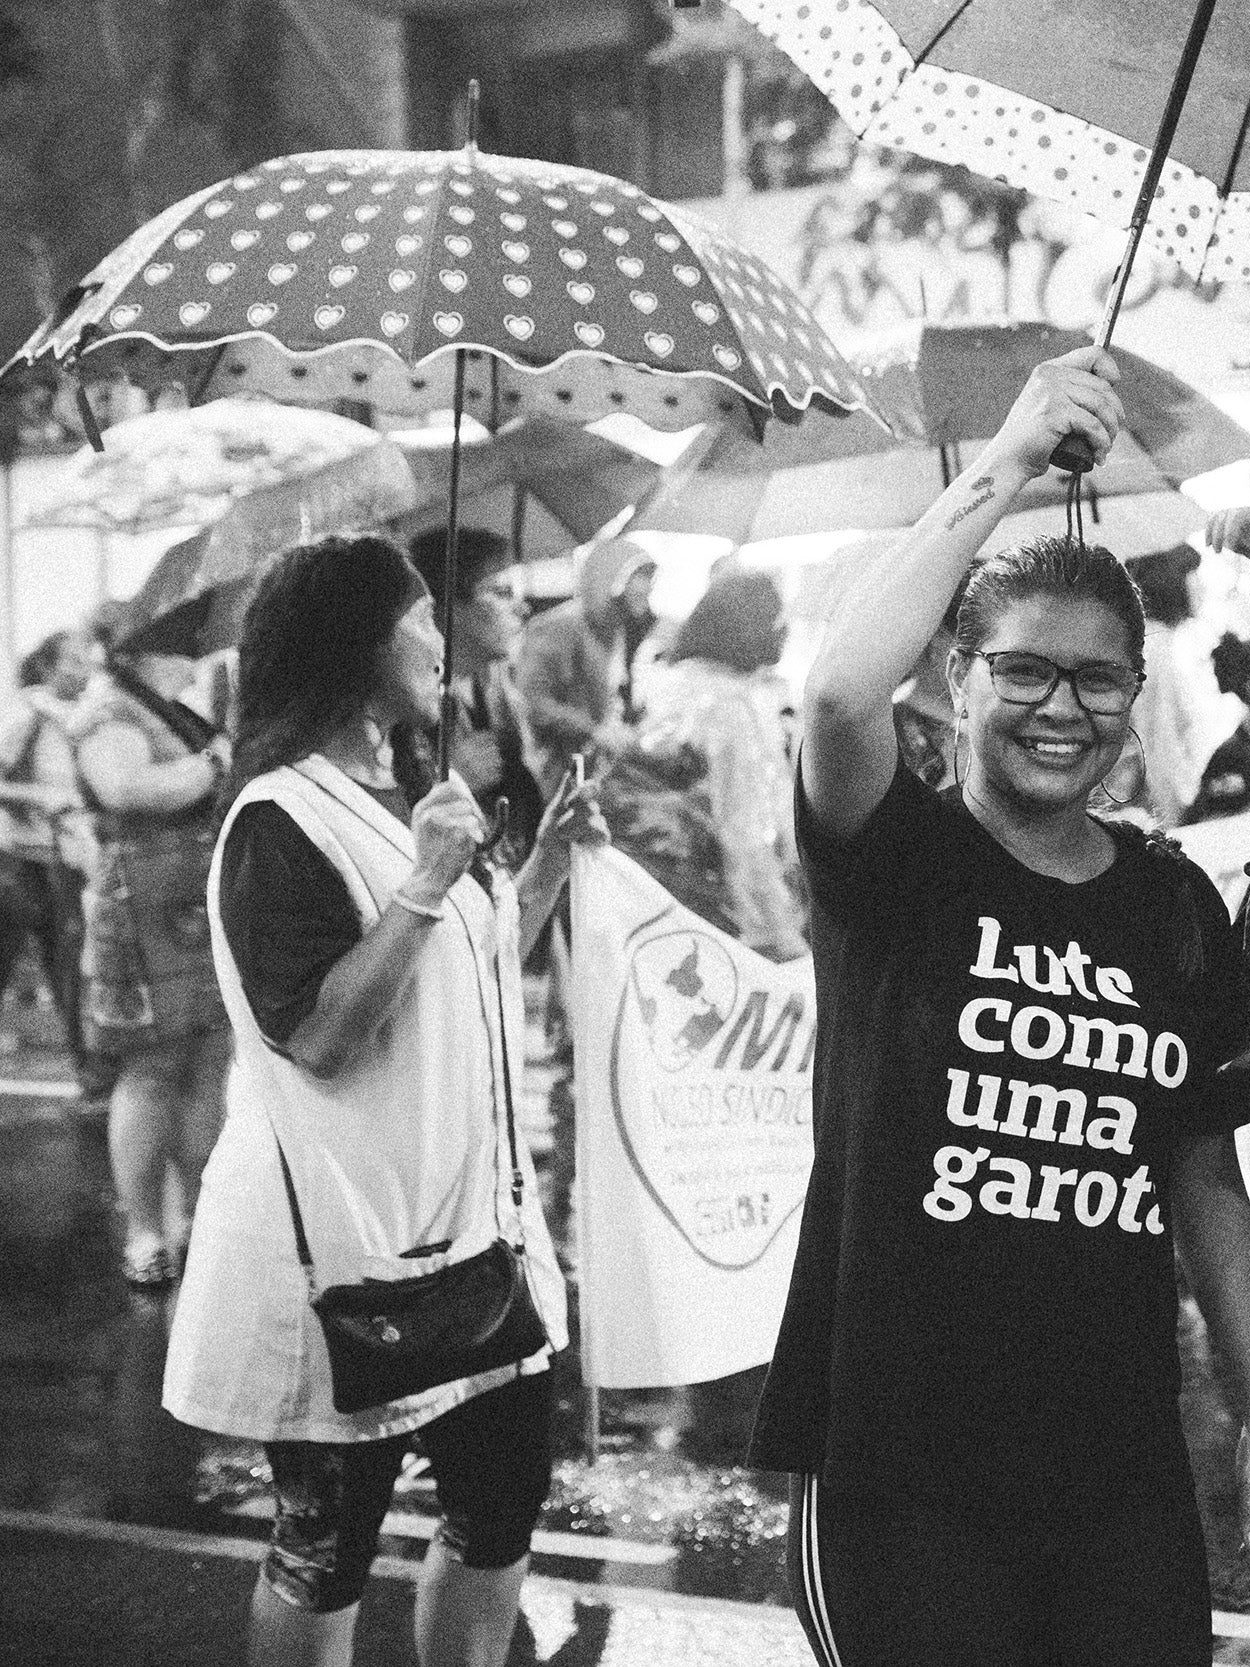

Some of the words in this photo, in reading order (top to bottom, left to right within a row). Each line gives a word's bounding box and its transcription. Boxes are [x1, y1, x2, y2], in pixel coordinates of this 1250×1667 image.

[969, 916, 1141, 1008] Lute
[714, 990, 817, 1072] M
[958, 997, 1188, 1089] como
[947, 1067, 1138, 1155] uma
